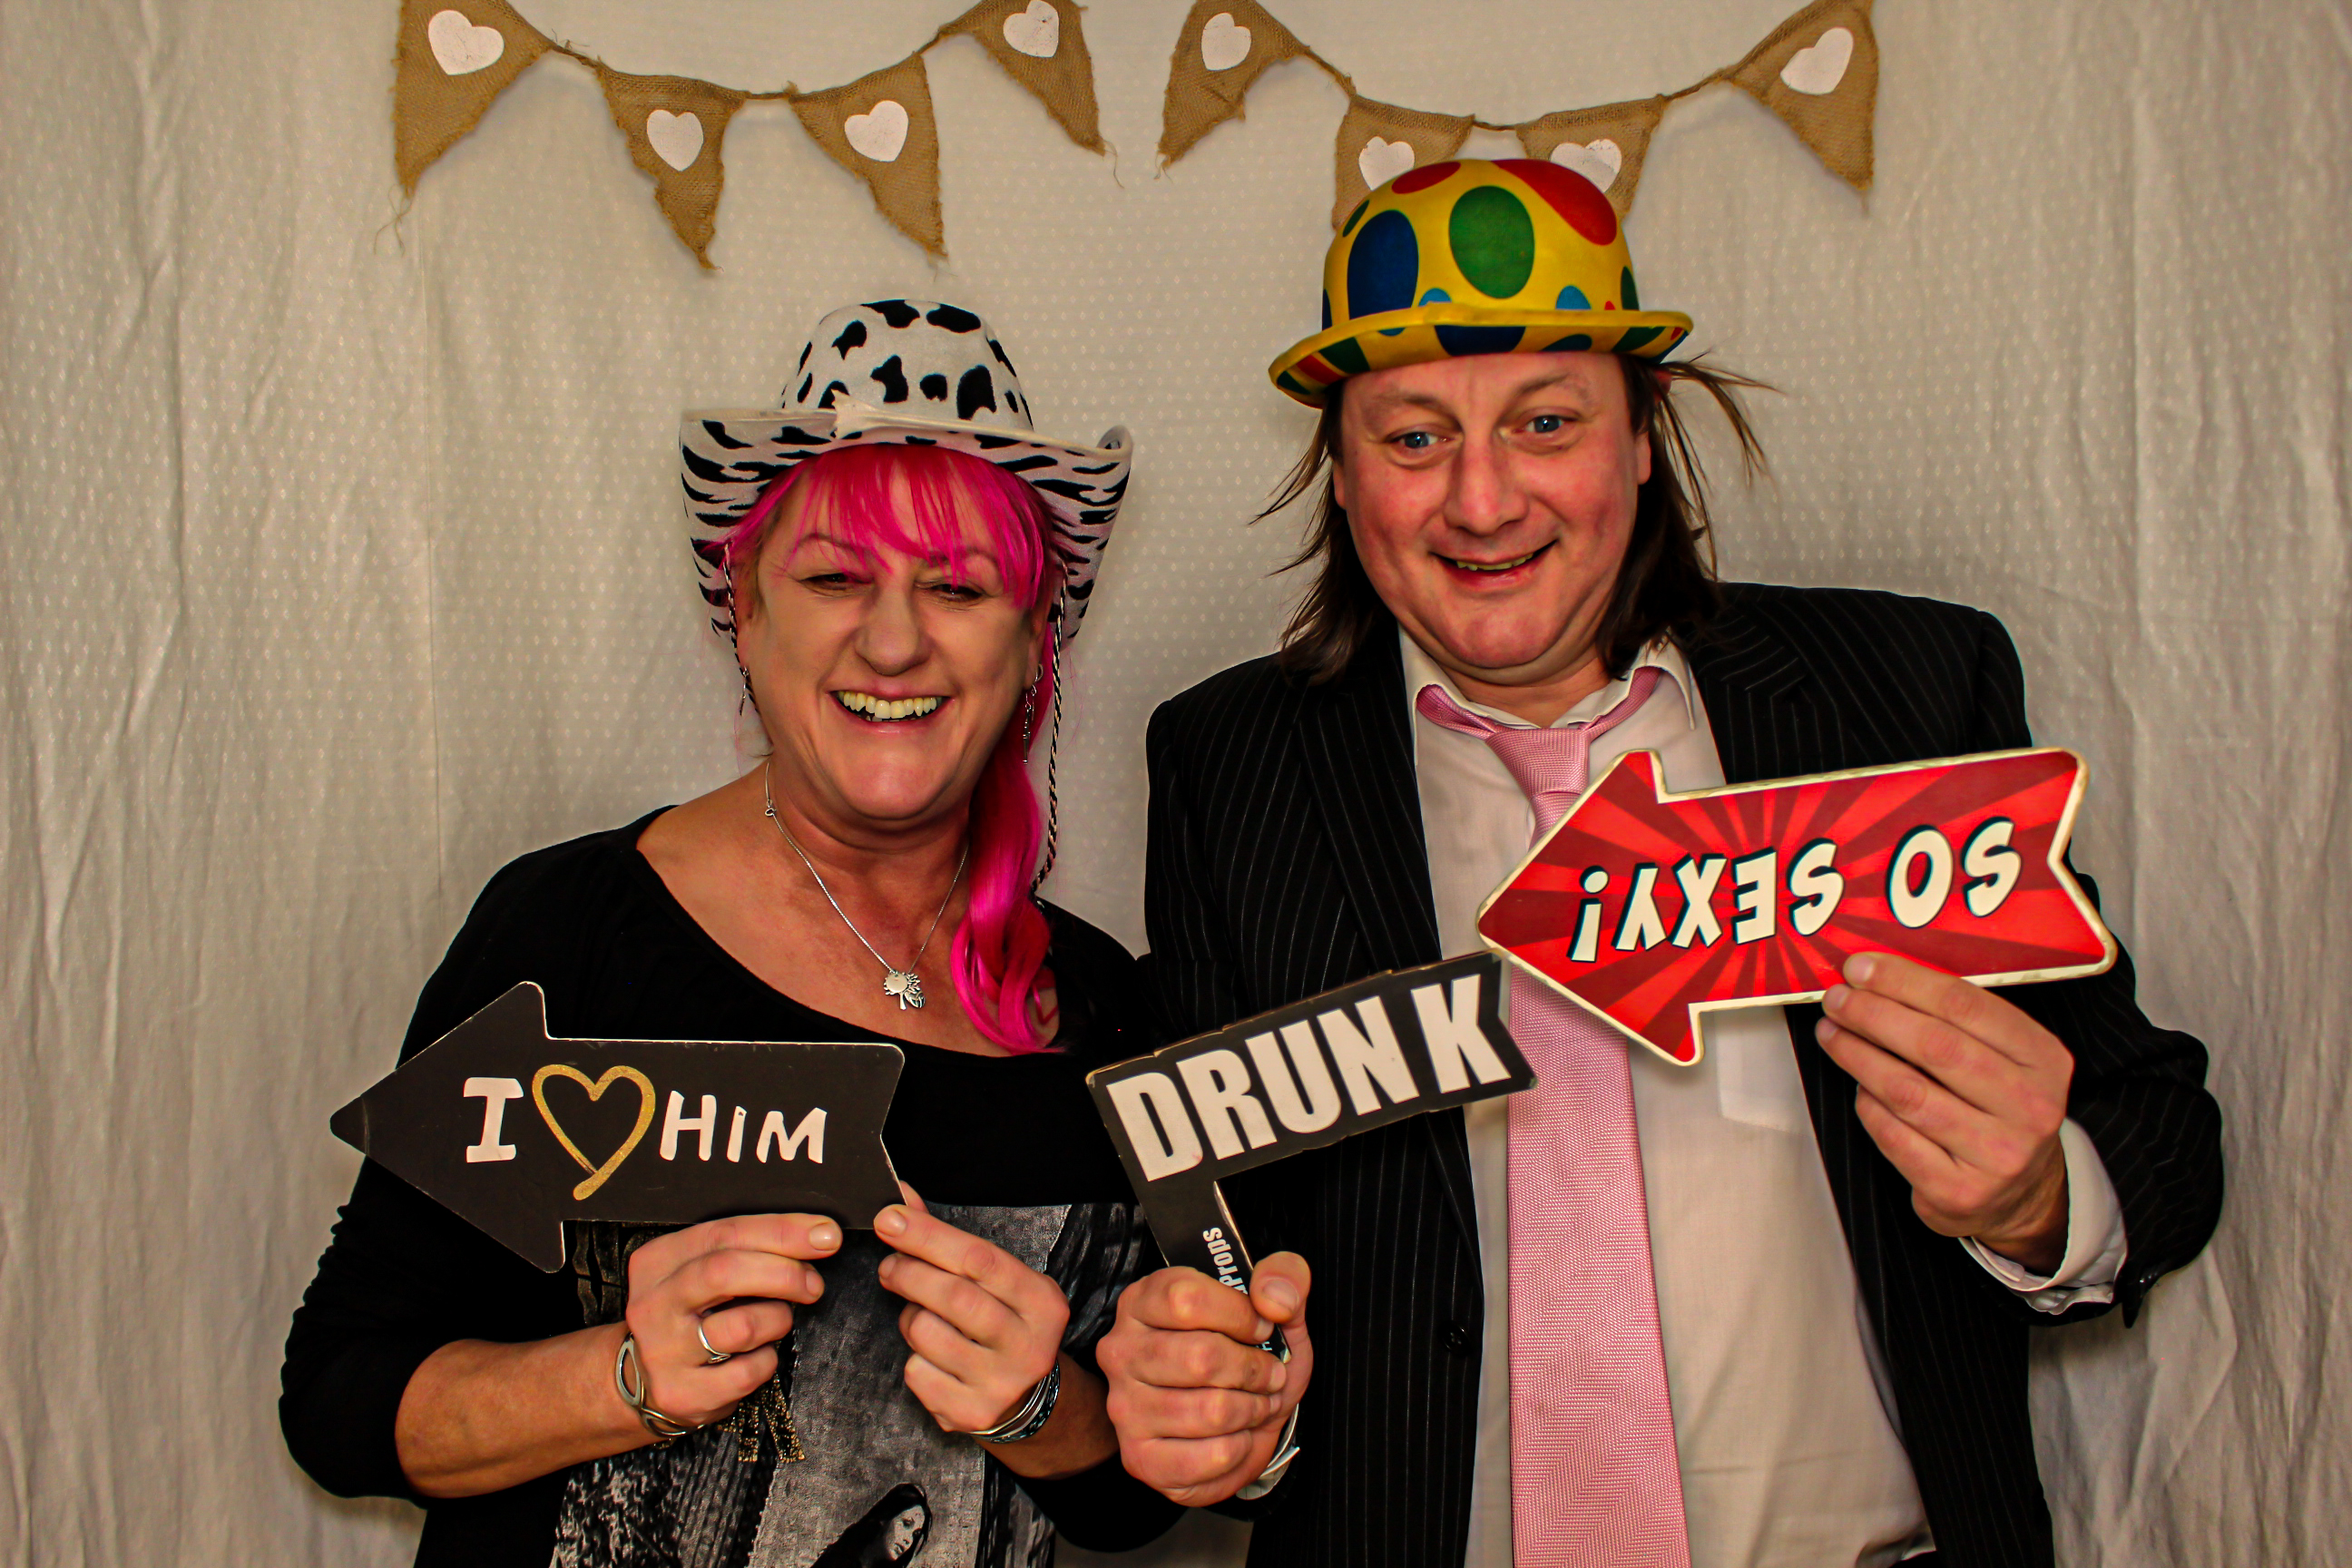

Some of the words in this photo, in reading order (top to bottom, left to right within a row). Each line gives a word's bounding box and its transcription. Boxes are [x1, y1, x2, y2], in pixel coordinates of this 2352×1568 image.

[1567, 838, 1845, 963] SEXY!
[1886, 816, 2022, 929] SO
[463, 1076, 524, 1163] I
[1105, 973, 1512, 1182] DRUNK
